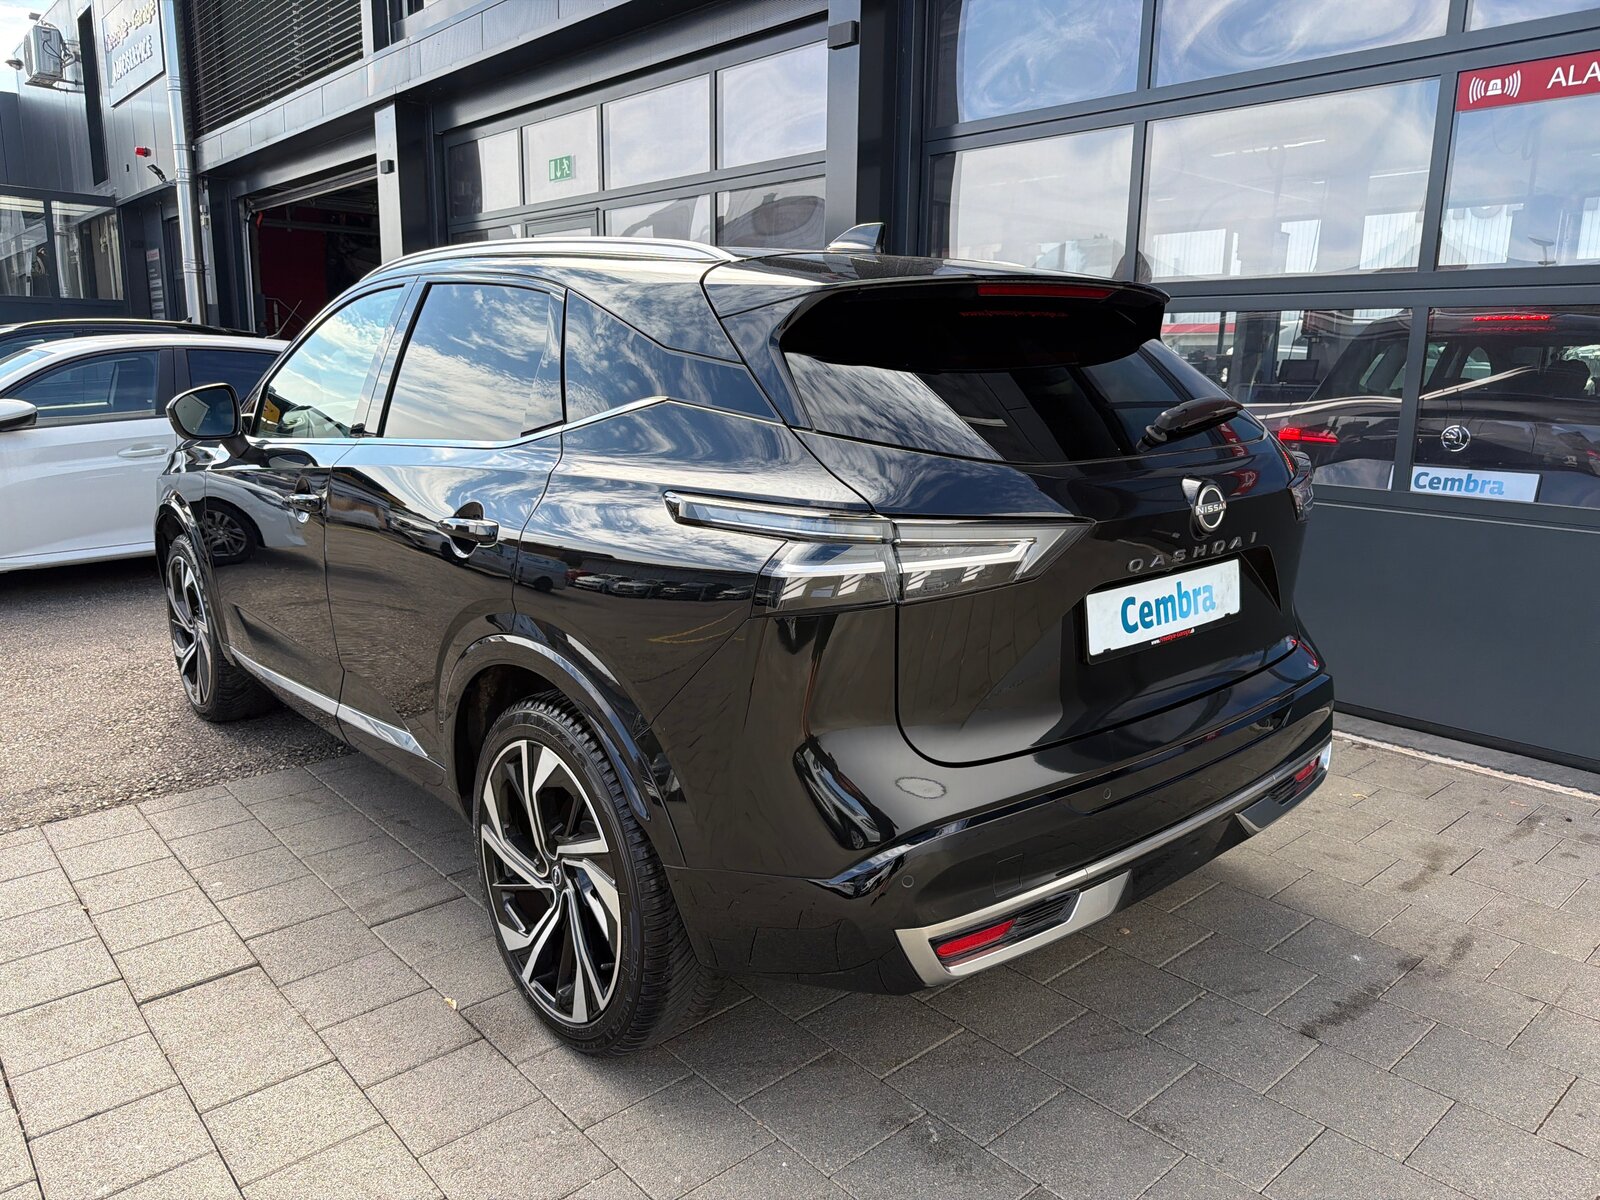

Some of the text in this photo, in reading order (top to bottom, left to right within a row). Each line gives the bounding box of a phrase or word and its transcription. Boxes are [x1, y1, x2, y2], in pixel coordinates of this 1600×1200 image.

[1414, 471, 1505, 496] Cembra
[1195, 501, 1227, 516] NISSAN
[1128, 532, 1257, 573] QASHQAI
[1121, 580, 1216, 634] Cembra
